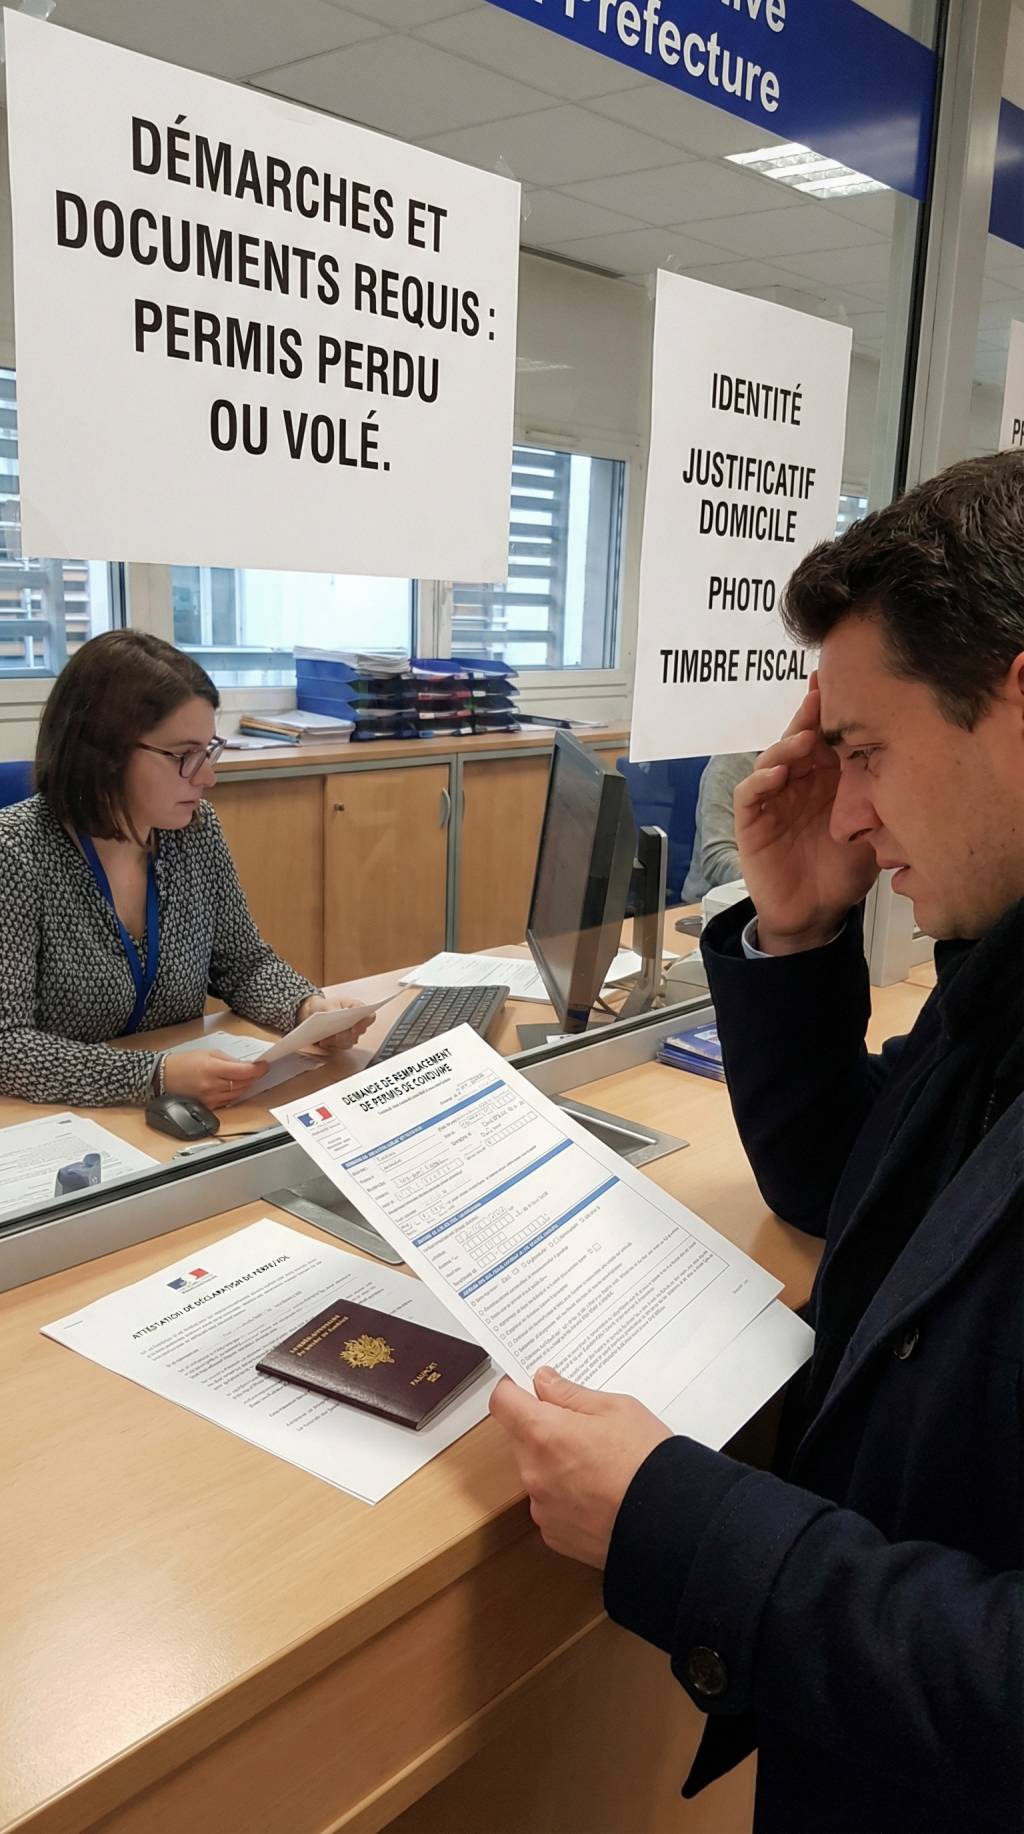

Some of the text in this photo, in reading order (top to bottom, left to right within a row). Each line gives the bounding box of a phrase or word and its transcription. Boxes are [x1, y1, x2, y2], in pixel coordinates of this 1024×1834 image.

[131, 114, 447, 253] DÉMARCHES ET
[55, 189, 340, 305] DOCUMENTS
[134, 298, 440, 403] PERMIS PERDU
[711, 373, 803, 426] IDENTITÉ
[210, 399, 391, 471] OU VOLÉ.
[682, 447, 816, 499] JUSTIFICATIF
[699, 499, 798, 543] DOMICILE
[708, 576, 776, 612] PHOTO
[660, 648, 808, 683] TIMBRE FISCAL
[359, 1100, 374, 1112] DE
[401, 1081, 415, 1093] DE
[380, 1076, 394, 1088] DE
